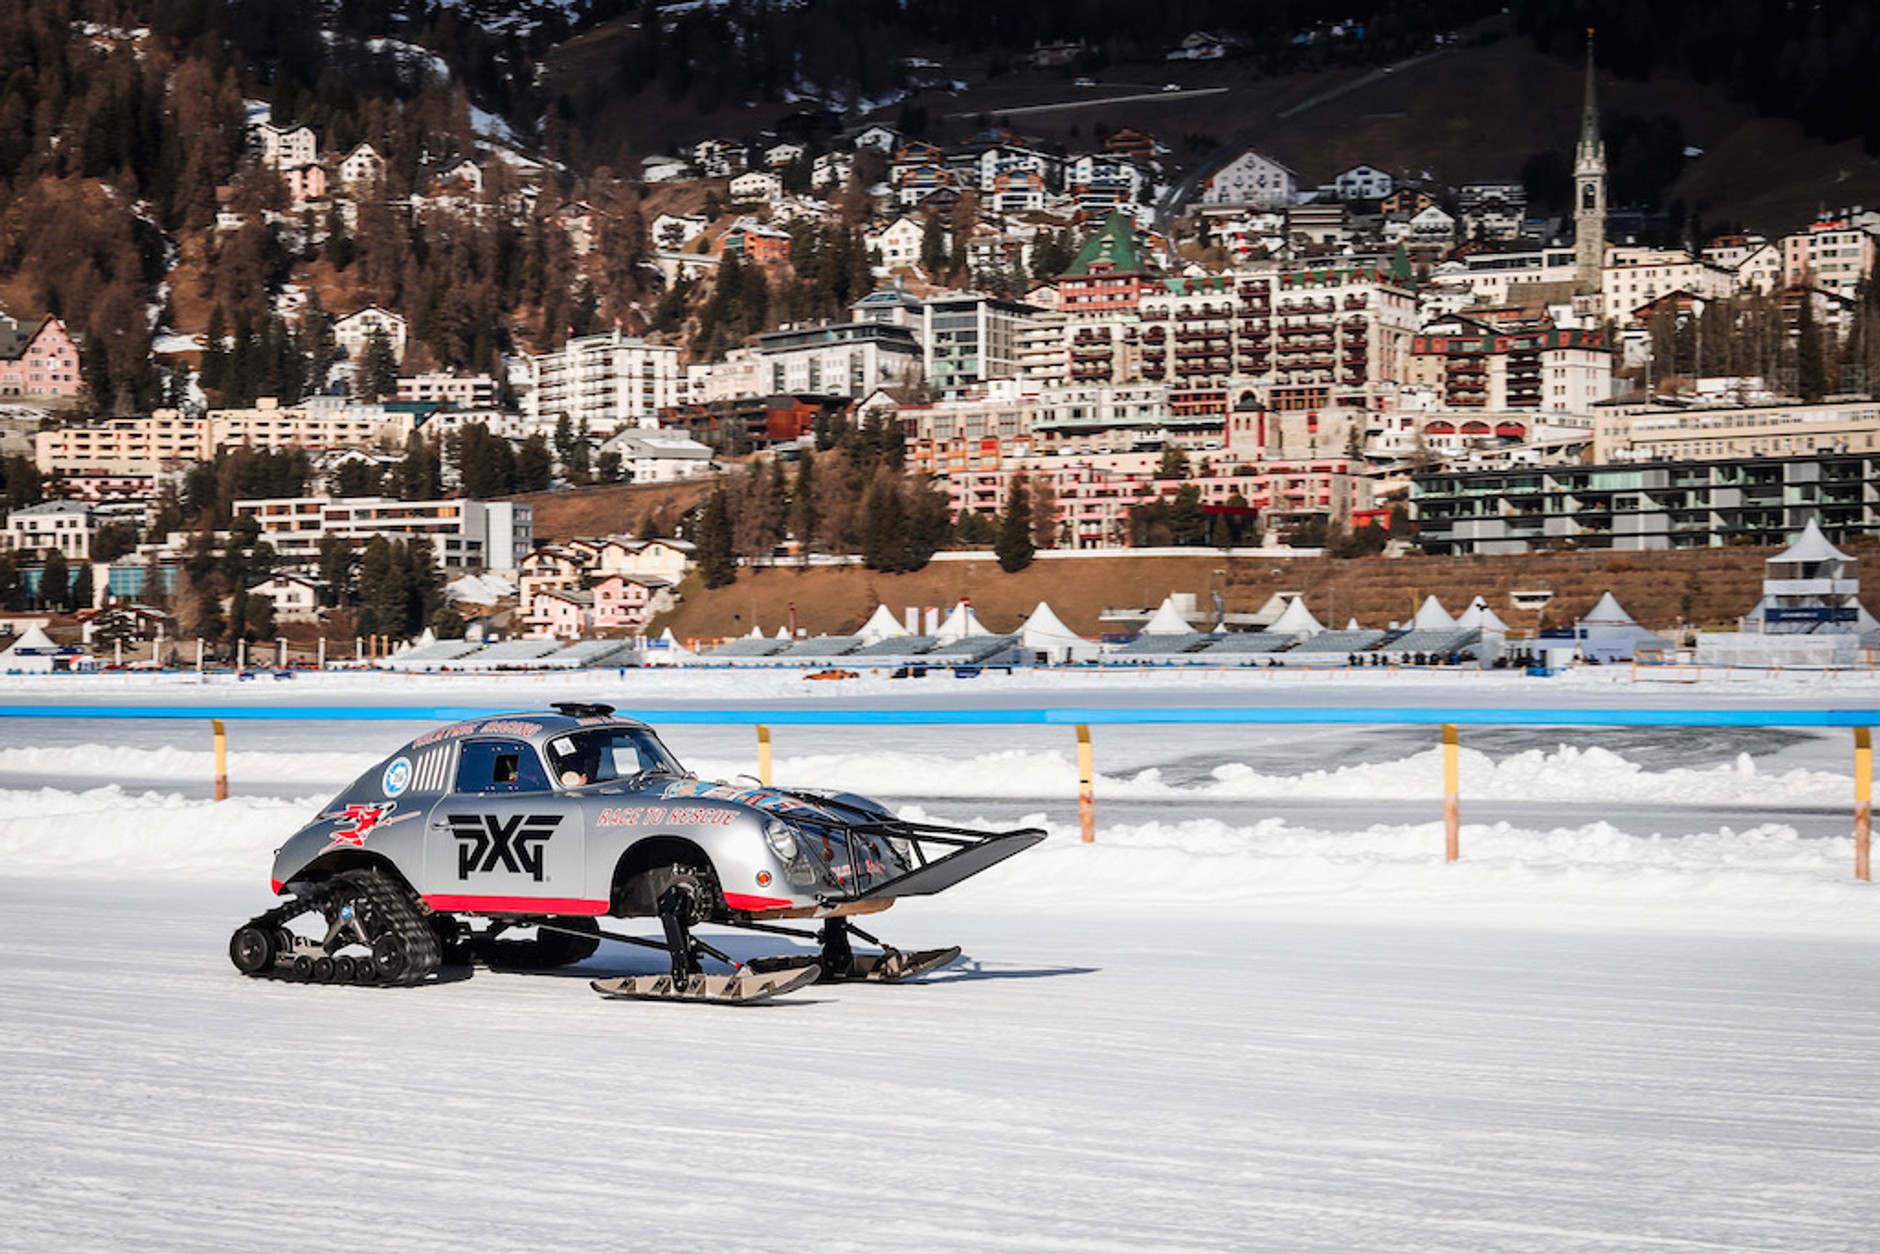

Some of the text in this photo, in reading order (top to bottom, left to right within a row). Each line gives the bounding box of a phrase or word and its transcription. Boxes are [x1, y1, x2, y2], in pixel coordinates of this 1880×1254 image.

[597, 807, 741, 827] RACE TO RESCUE
[447, 815, 565, 882] PXG
